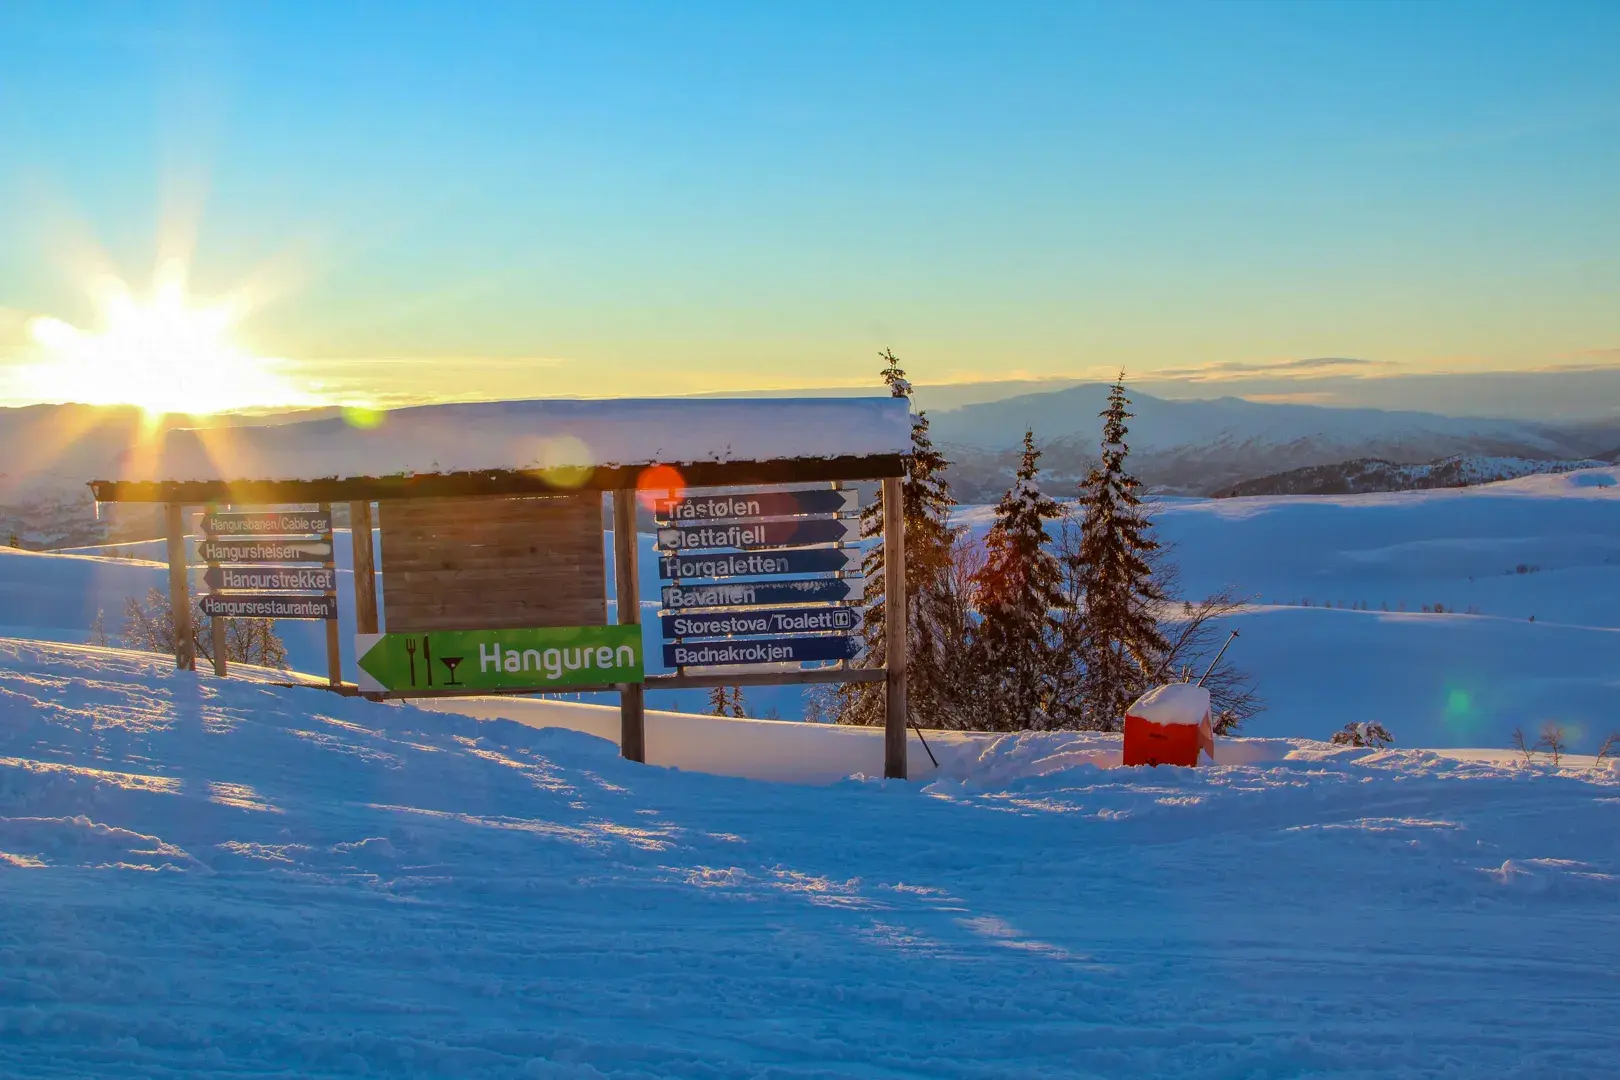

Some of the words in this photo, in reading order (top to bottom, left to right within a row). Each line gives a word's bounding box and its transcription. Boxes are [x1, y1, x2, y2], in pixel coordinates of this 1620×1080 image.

[664, 498, 760, 519] Tråstølen
[210, 516, 309, 533] Hangursbanen/Cable
[311, 519, 327, 530] car
[666, 526, 766, 548] Slettafjell
[206, 543, 300, 561] Hangursheisen
[665, 555, 789, 577] Horgaletten
[222, 570, 332, 589] Hangurstrekket
[205, 598, 329, 616] Hangursrestauranten
[674, 612, 832, 635] Storestova/Toalett
[479, 642, 635, 680] Hanguren
[675, 644, 794, 664] Badnakrokjen
